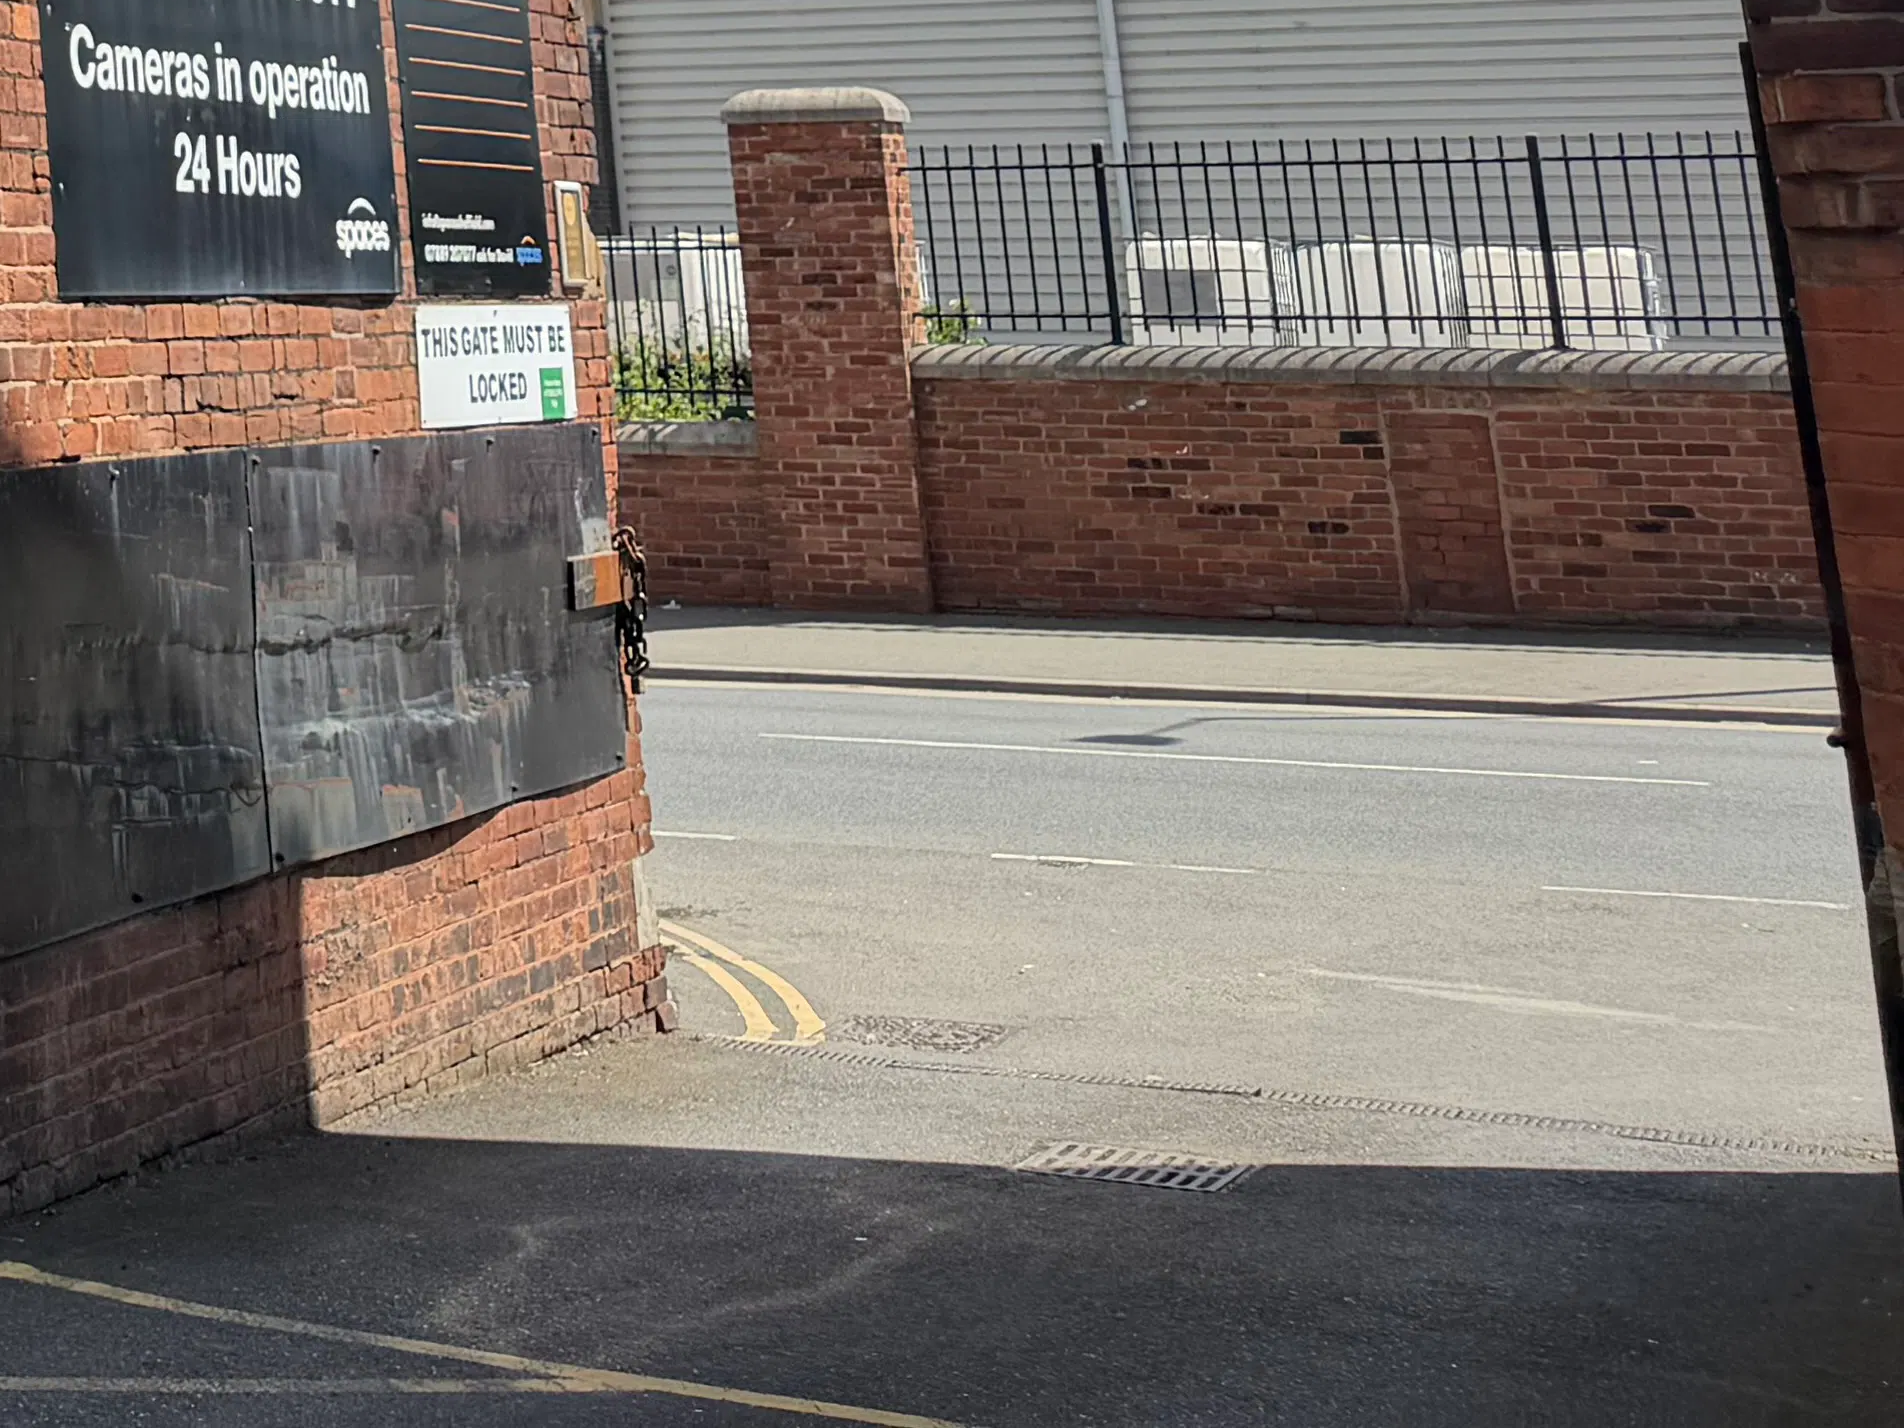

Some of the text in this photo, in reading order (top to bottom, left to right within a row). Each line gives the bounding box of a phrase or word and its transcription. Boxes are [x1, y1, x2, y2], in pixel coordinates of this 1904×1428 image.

[69, 23, 371, 119] Cameras in operation
[174, 131, 302, 198] 24 Hours
[336, 219, 390, 258] spaces
[421, 324, 566, 358] THIS GATE MUST BE
[469, 372, 528, 403] LOCKED
